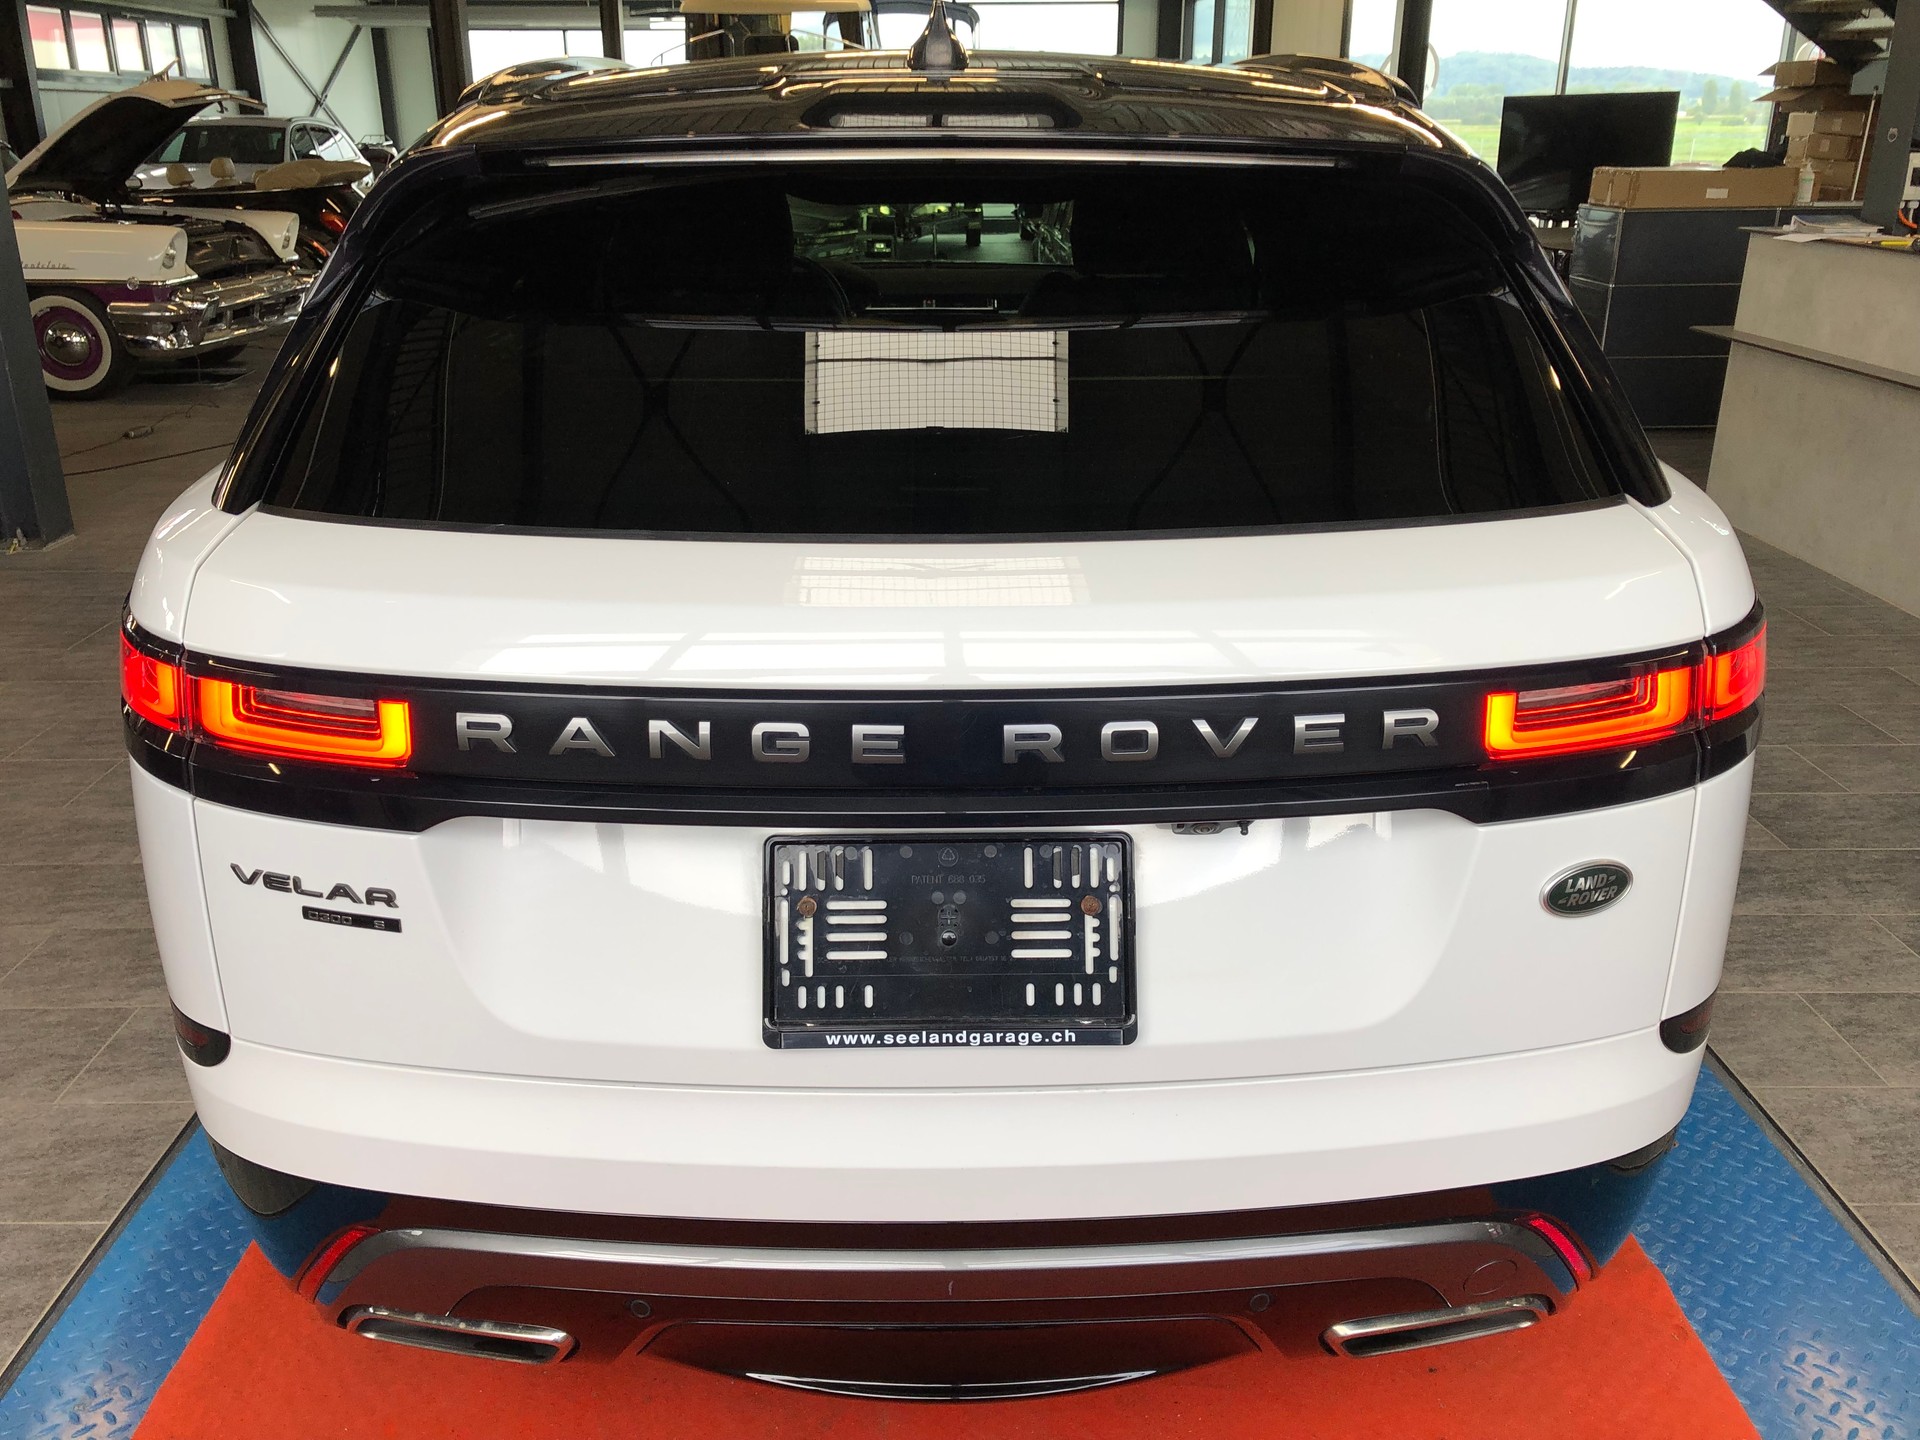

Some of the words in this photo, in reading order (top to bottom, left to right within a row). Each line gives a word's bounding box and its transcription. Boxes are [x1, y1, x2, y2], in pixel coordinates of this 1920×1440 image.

[455, 711, 907, 765] RANGE
[1002, 708, 1440, 764] ROVER
[229, 862, 400, 909] VELAR
[911, 874, 943, 884] PATENT
[1564, 873, 1608, 893] LAND
[1566, 885, 1618, 907] ROVER
[825, 1030, 1077, 1047] www.seelandgarage.ch
